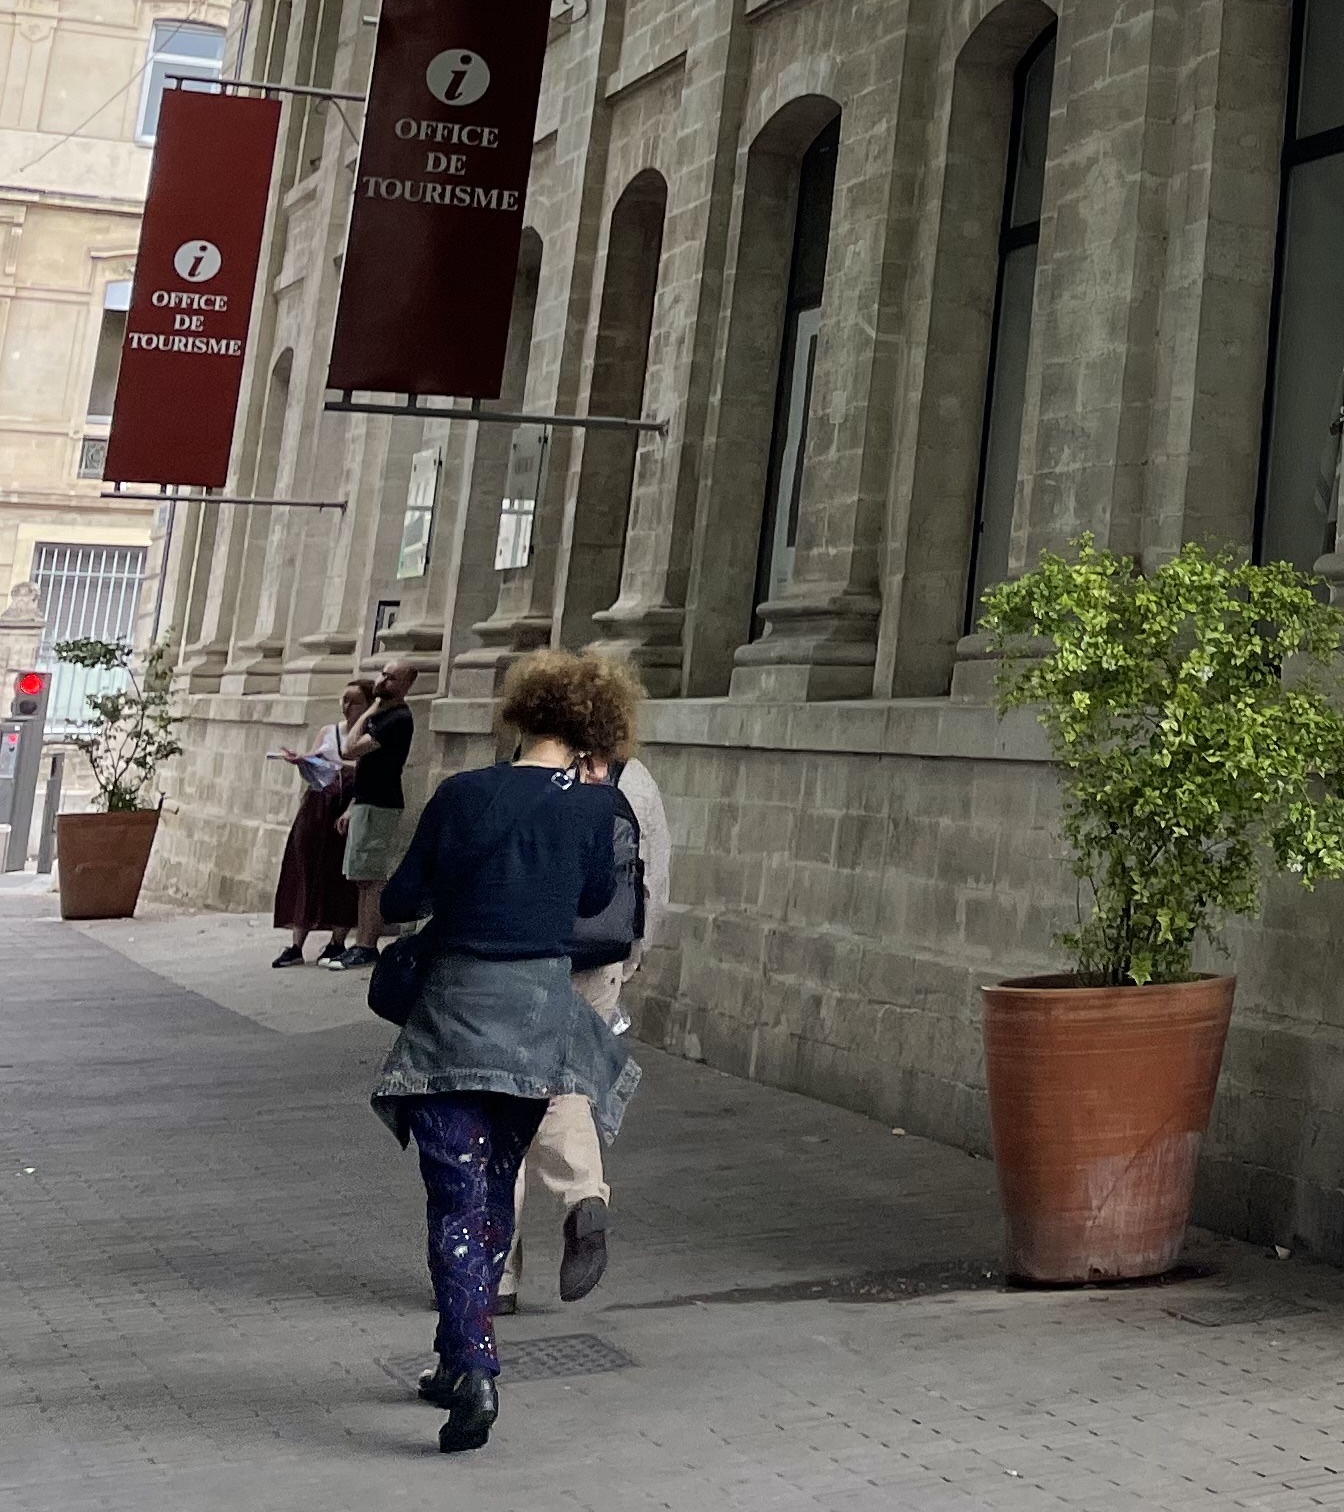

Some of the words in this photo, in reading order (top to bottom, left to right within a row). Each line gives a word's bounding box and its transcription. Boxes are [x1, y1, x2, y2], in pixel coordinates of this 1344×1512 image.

[394, 117, 499, 149] OFFICE
[425, 151, 467, 176] DE
[362, 176, 519, 211] TOURISME
[151, 290, 228, 312] OFFICE
[173, 313, 205, 332] DE
[128, 332, 242, 356] TOURISME
